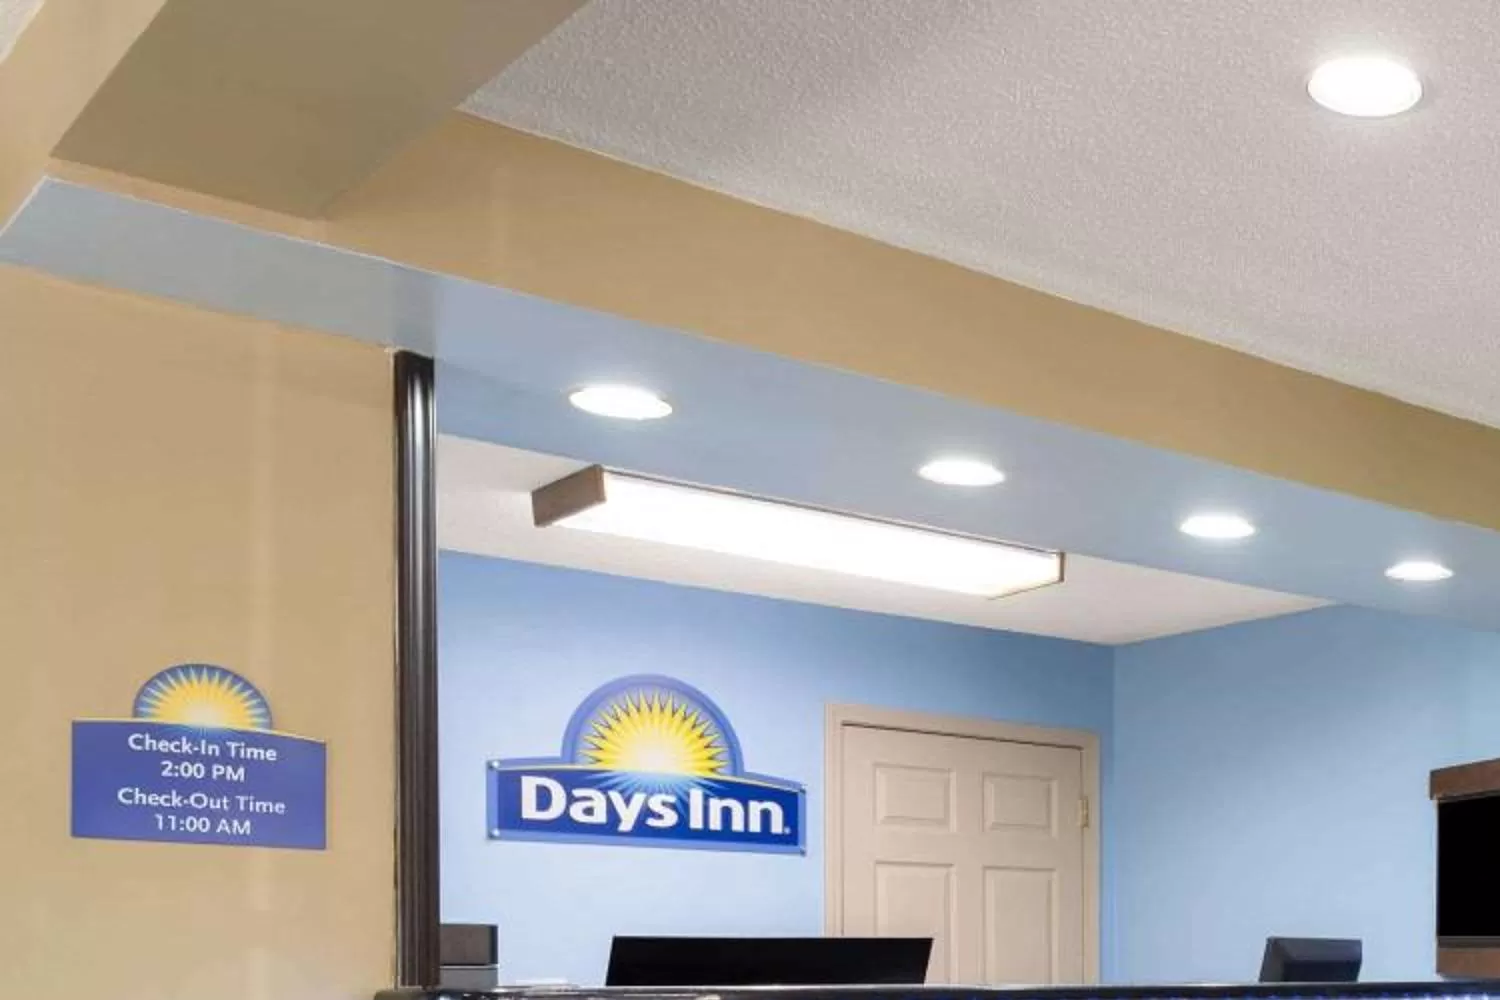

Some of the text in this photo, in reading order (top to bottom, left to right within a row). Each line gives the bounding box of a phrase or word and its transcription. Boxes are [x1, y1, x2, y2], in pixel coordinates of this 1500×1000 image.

[128, 733, 278, 762] Check-In Time
[160, 760, 246, 782] 2:00 PM
[117, 787, 286, 815] Check-Out Time
[154, 813, 251, 836] 11:00 AM
